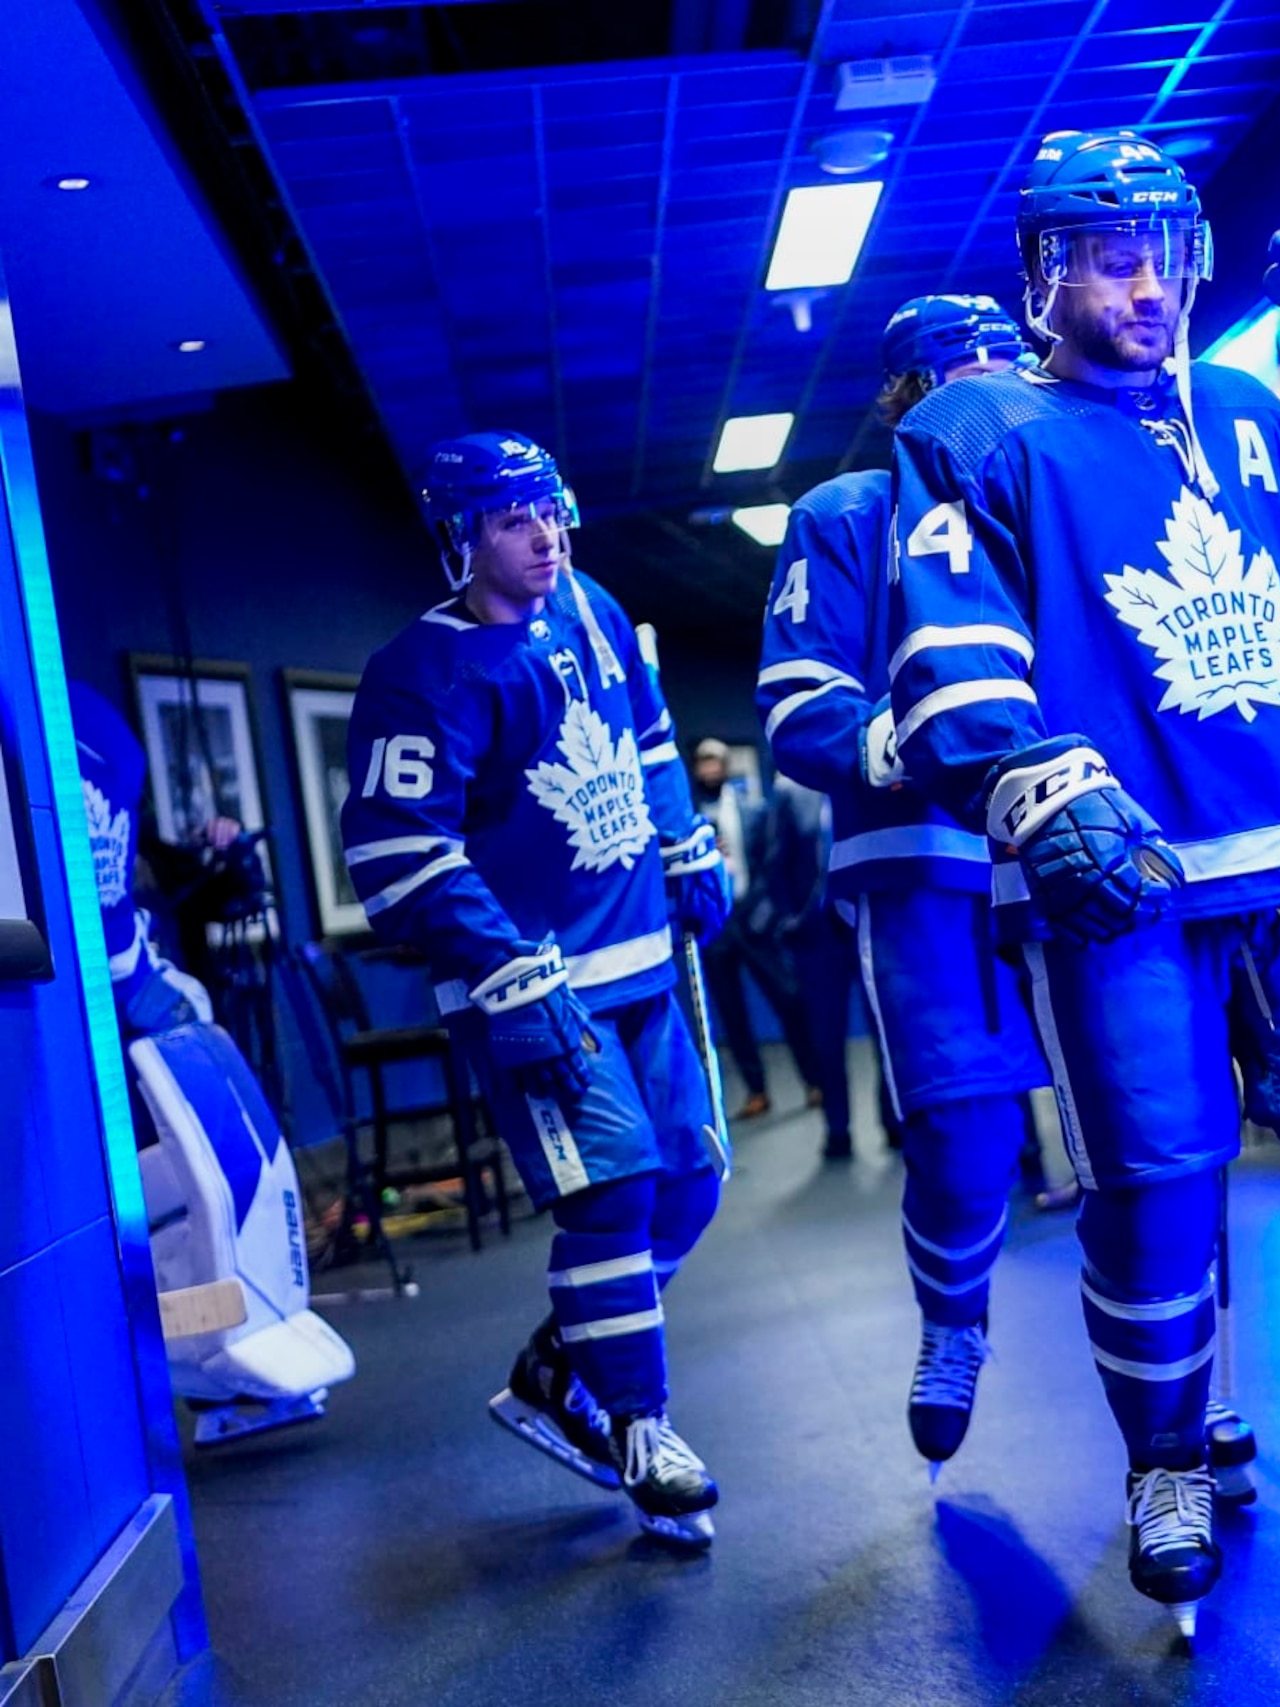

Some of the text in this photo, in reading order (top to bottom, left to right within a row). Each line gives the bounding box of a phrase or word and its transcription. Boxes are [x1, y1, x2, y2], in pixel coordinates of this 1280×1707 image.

[1132, 191, 1179, 204] CCM
[1234, 419, 1278, 493] A
[1156, 591, 1276, 638] TORONTO
[1183, 621, 1267, 655] MAPLE
[1190, 648, 1273, 681] LEAFS
[361, 733, 436, 799] 16
[565, 771, 635, 813] TORONTO
[583, 792, 633, 824] MAPLE
[1003, 762, 1111, 838] CCM
[589, 811, 637, 844] LEAFS
[541, 1109, 568, 1161] CCM
